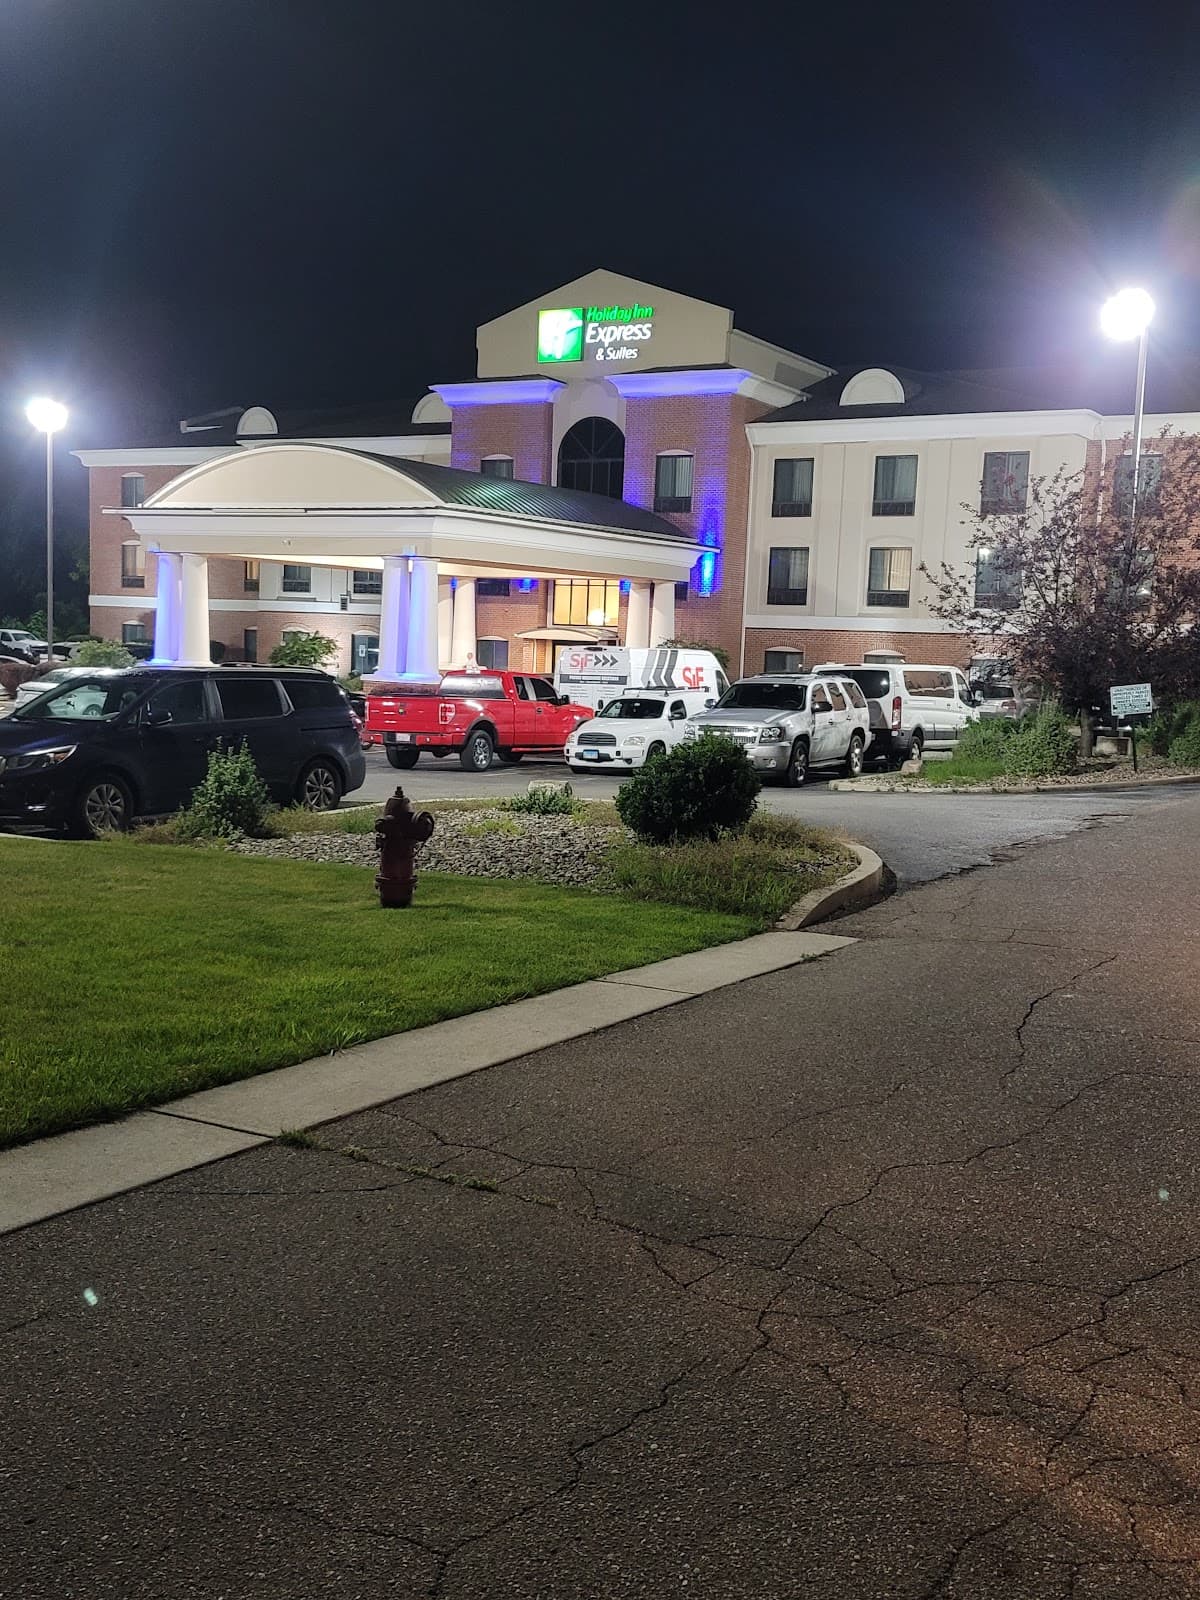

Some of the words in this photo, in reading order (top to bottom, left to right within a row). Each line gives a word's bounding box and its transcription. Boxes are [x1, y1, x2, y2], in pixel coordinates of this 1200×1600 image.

[587, 306, 632, 322] Holiday
[633, 303, 654, 318] Inn
[585, 322, 652, 347] Express
[595, 347, 605, 361] &
[606, 346, 638, 360] Suites
